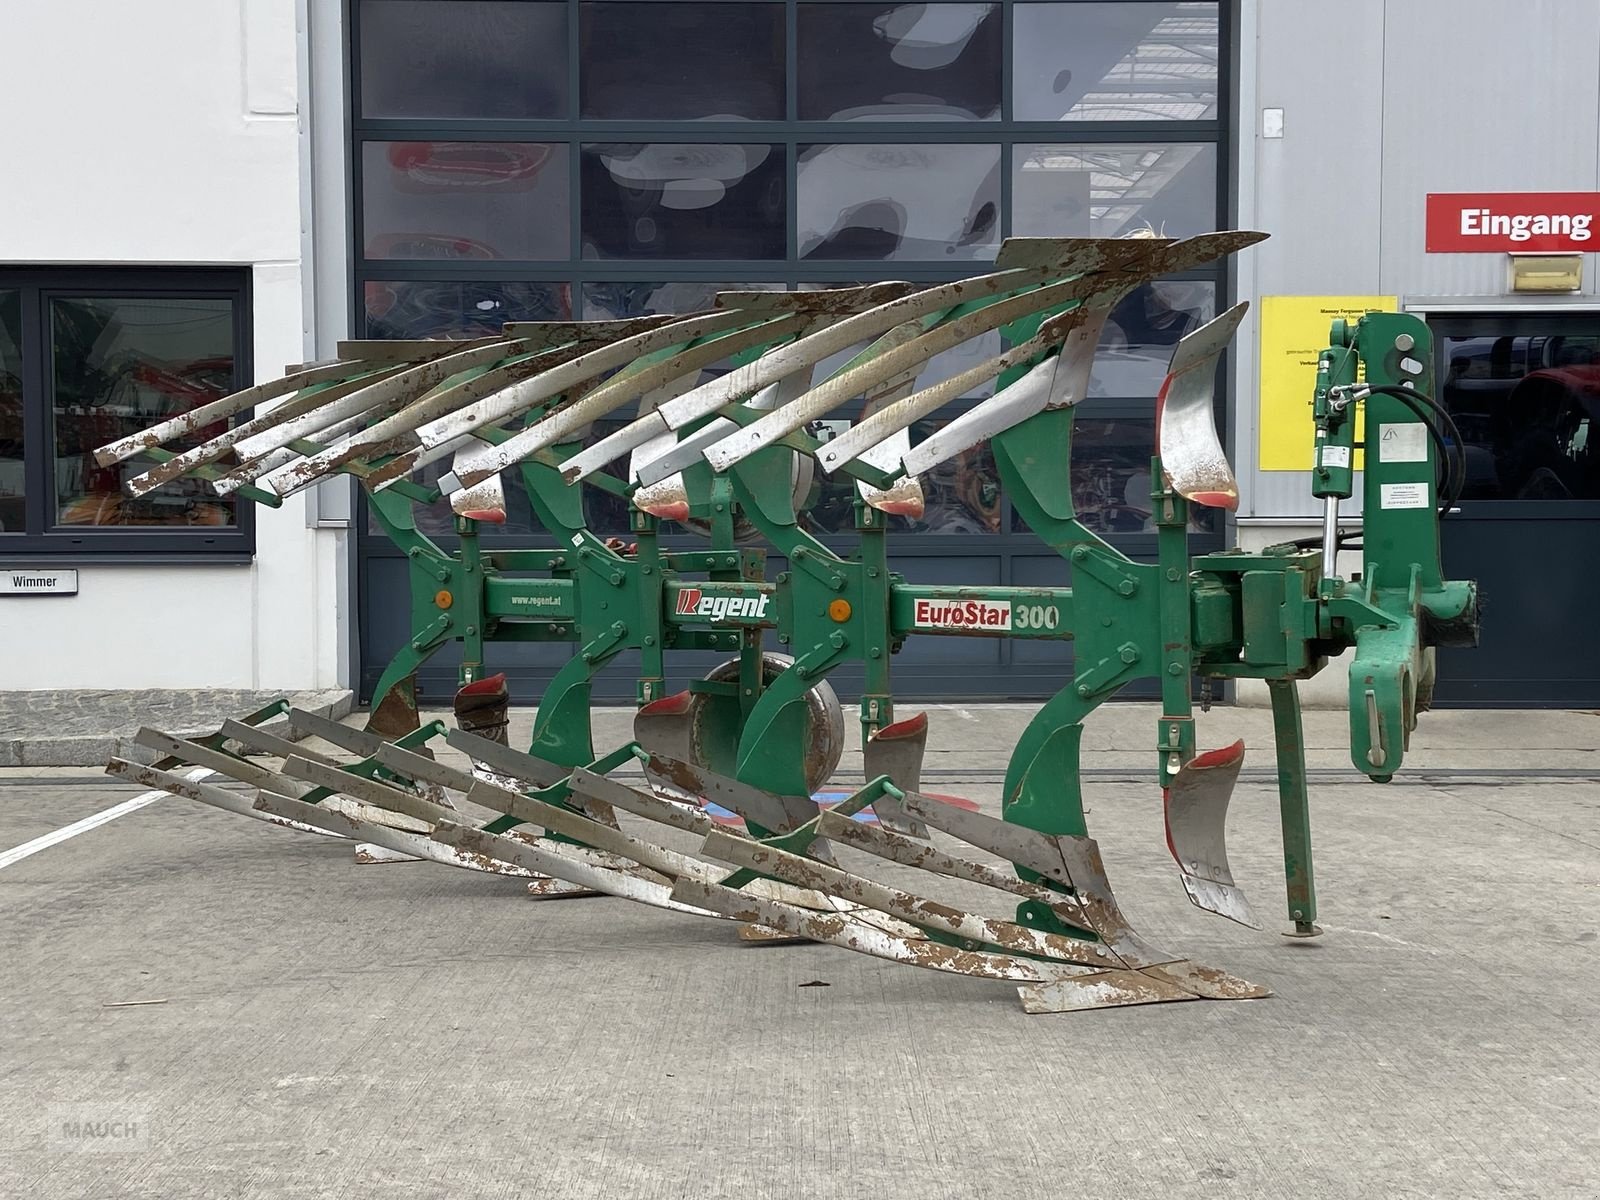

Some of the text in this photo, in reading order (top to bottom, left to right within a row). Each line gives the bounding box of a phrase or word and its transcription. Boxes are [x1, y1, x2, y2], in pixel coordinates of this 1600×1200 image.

[1461, 208, 1592, 241] Eingang
[13, 576, 57, 587] Wimmer
[511, 596, 561, 607] www.regent.at
[675, 588, 770, 622] Regent
[916, 601, 1060, 630] EuroStar 300
